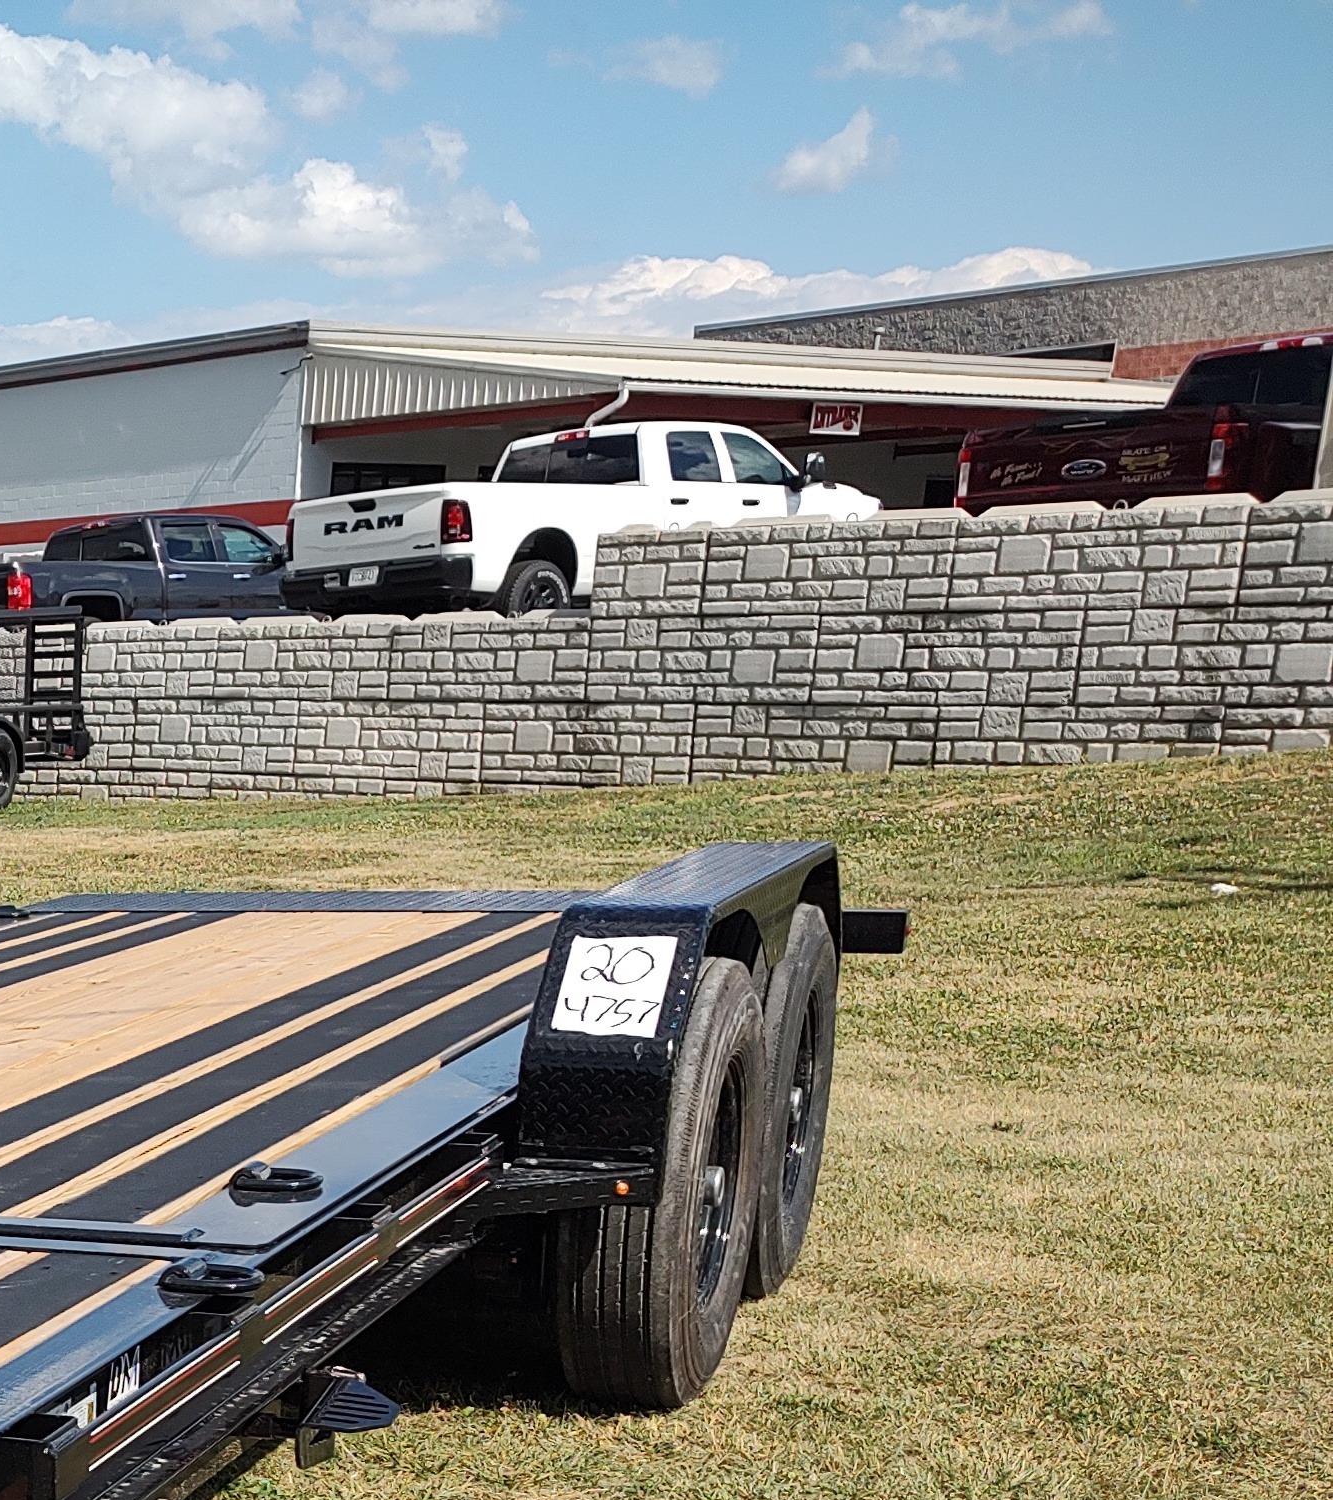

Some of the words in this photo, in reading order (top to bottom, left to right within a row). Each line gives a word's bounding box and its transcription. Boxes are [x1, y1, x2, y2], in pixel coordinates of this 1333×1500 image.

[323, 513, 404, 536] RAM
[580, 943, 655, 985] 20
[564, 995, 661, 1028] 4757
